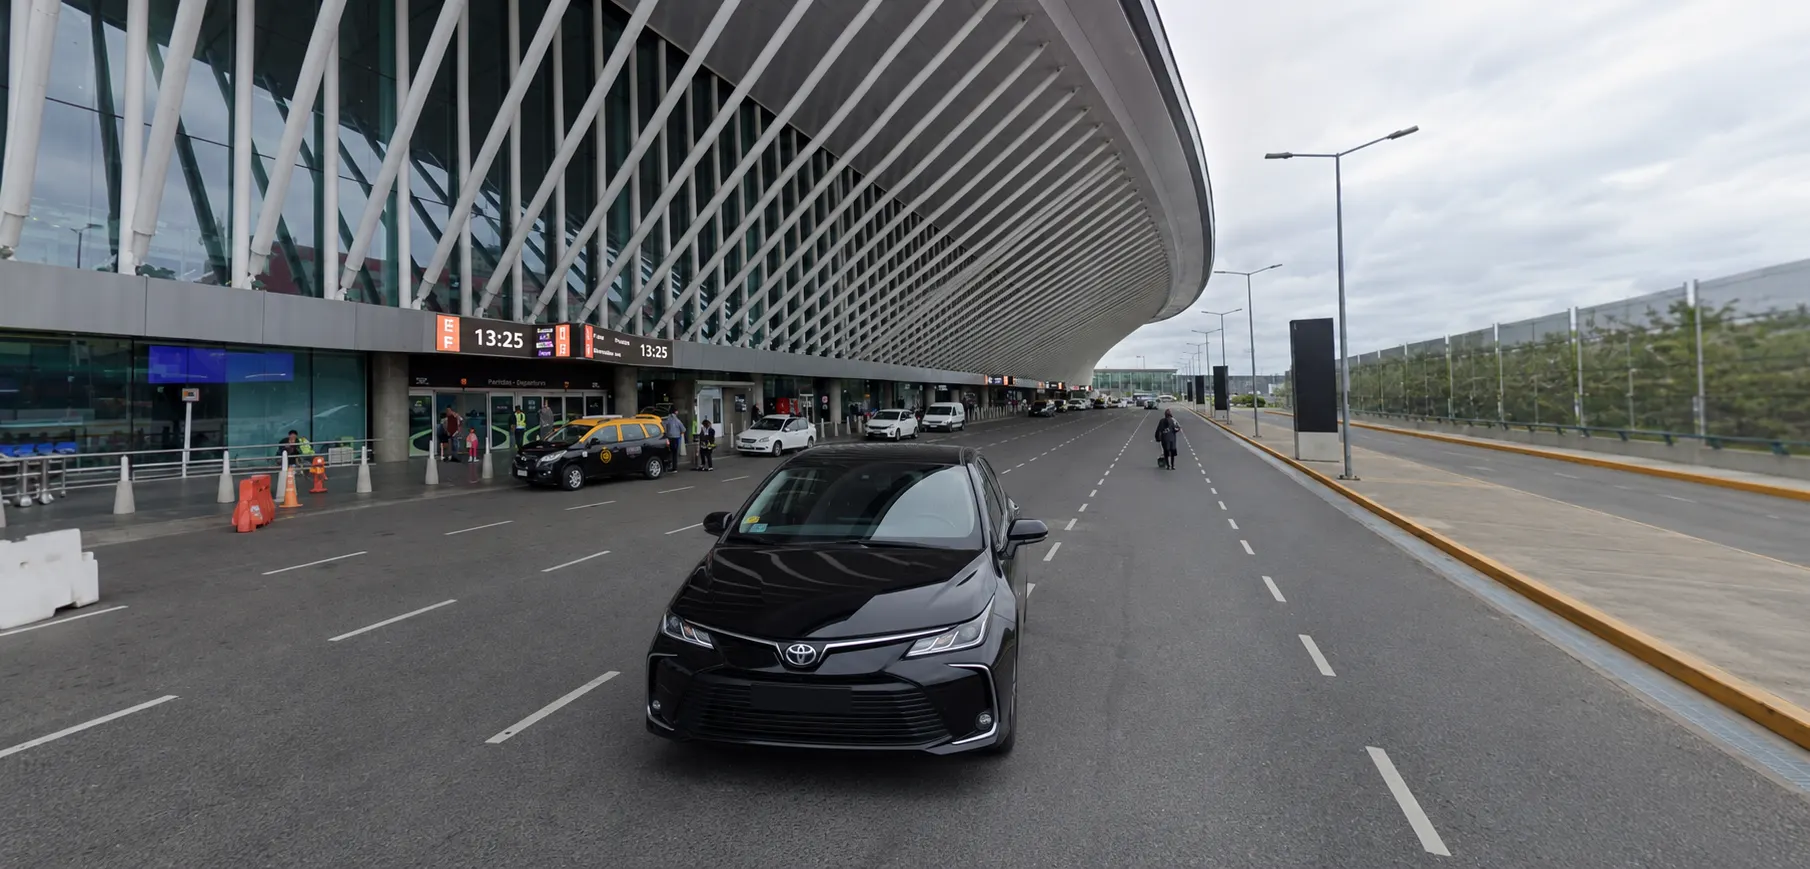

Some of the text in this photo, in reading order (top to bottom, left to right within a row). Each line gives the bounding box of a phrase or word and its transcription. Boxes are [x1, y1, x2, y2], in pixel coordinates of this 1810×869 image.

[444, 318, 453, 332] E
[444, 335, 453, 348] F
[475, 328, 523, 348] 13:25
[640, 343, 668, 358] 13:25
